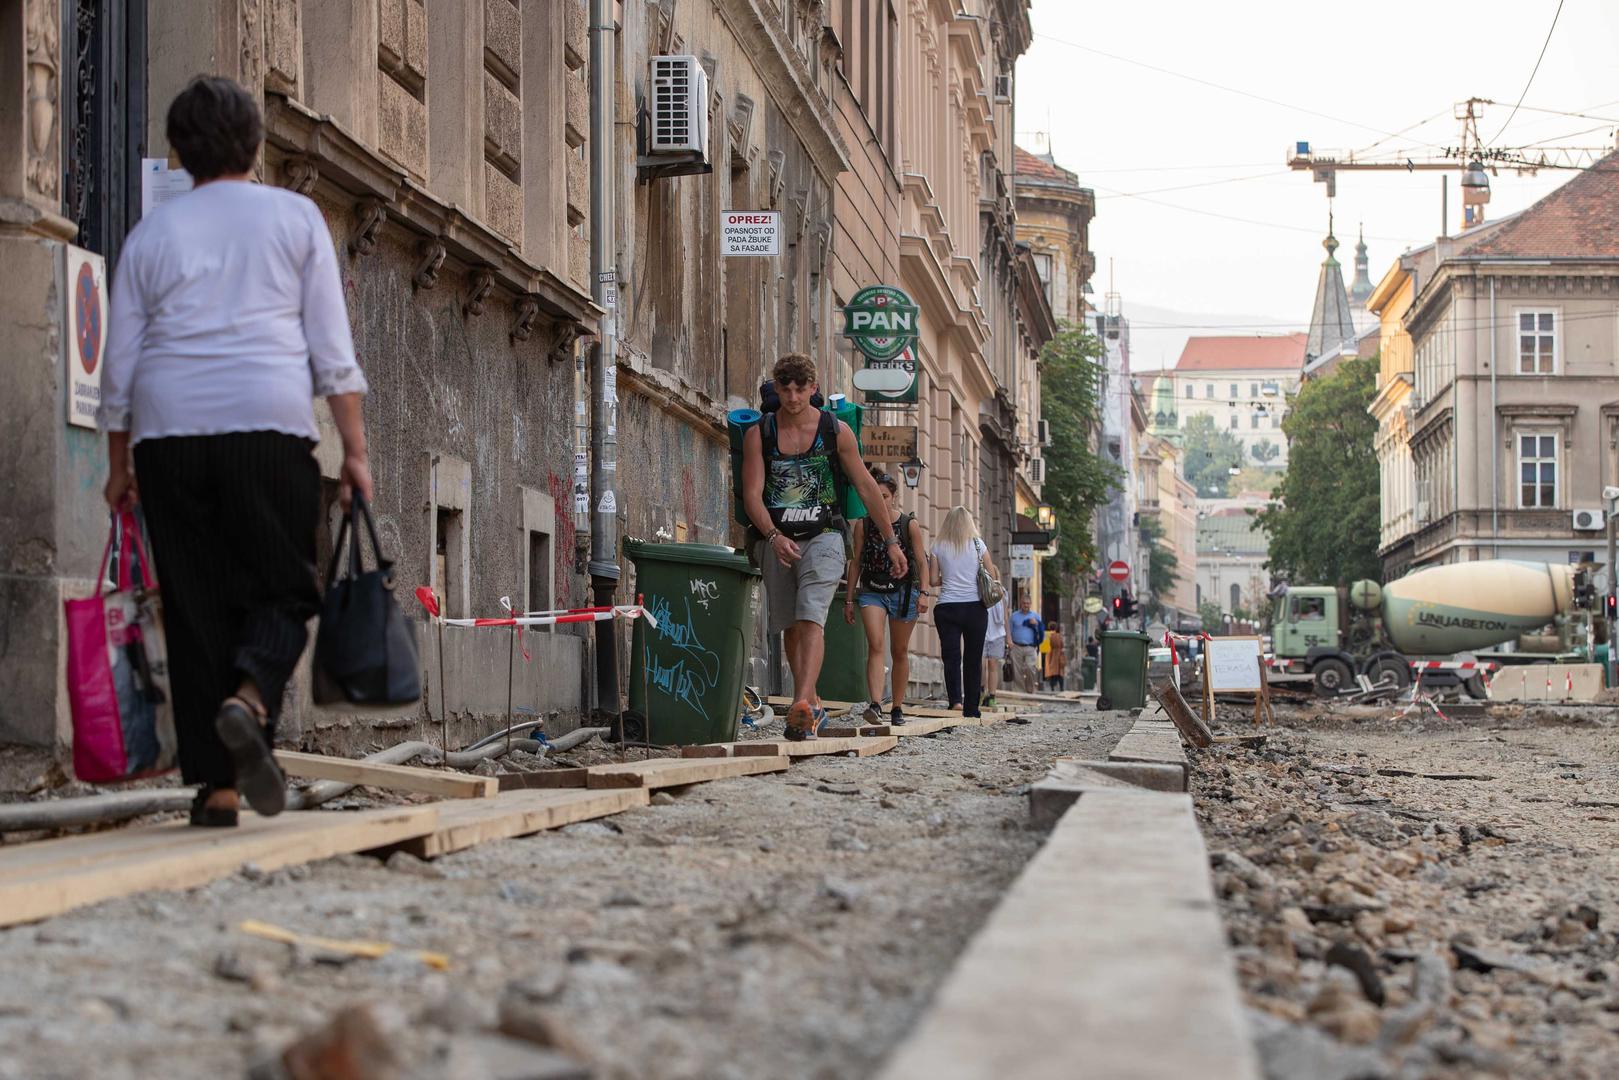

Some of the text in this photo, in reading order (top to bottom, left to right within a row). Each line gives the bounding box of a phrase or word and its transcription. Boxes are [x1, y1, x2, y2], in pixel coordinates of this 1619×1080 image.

[728, 215, 772, 224] OPREZ!
[724, 227, 775, 235] OPASNOST OD
[748, 234, 772, 243] ŽBUKE
[877, 297, 884, 305] P
[852, 311, 911, 330] PAN
[781, 506, 821, 522] NIKE
[1418, 611, 1507, 631] UNIJABETON
